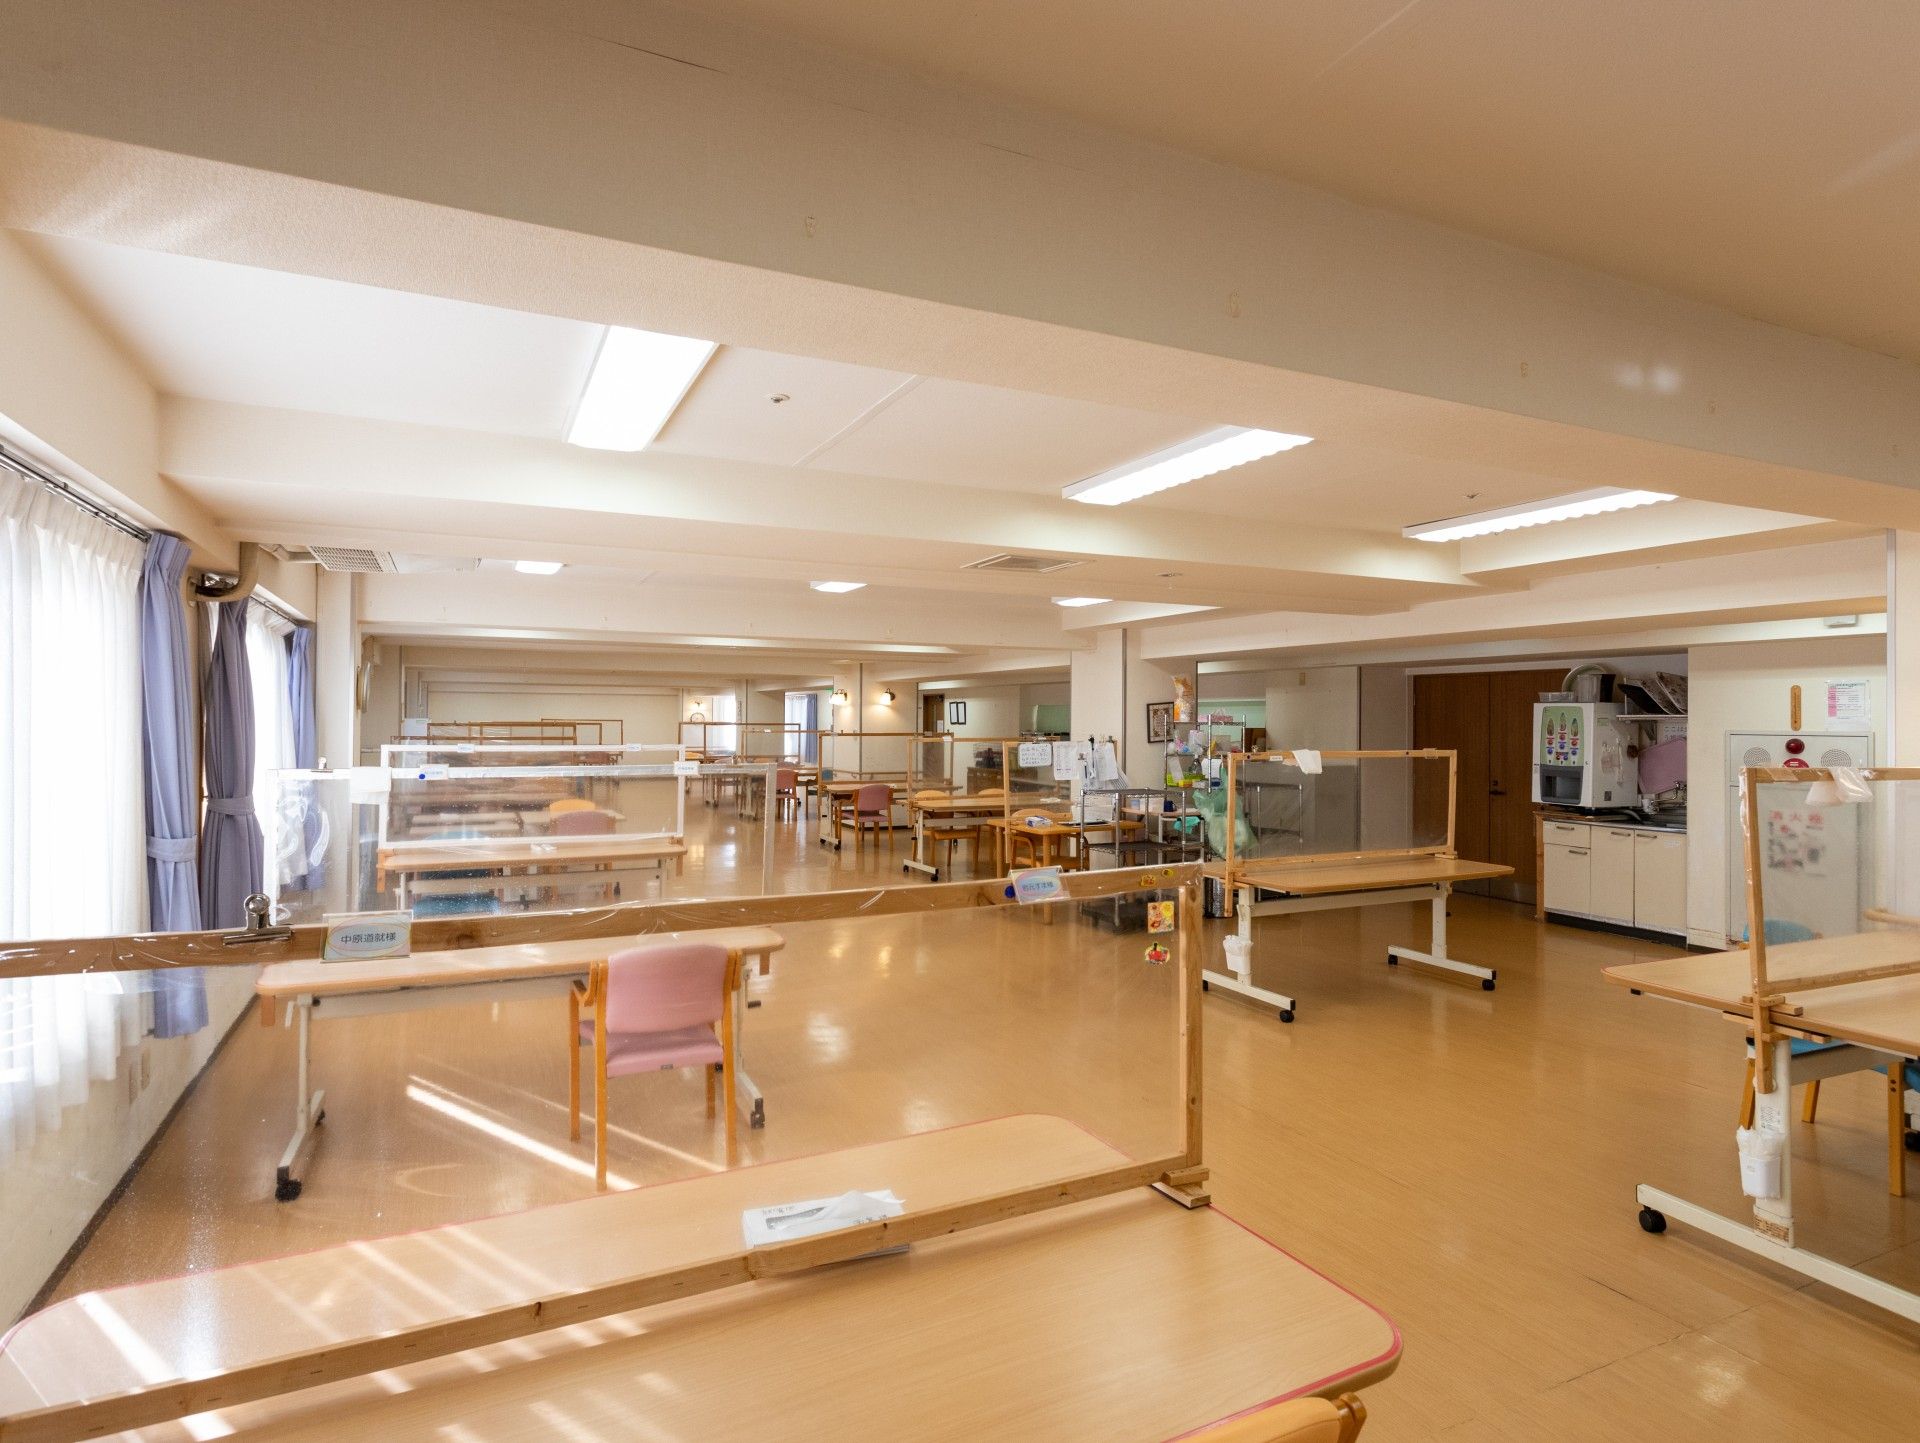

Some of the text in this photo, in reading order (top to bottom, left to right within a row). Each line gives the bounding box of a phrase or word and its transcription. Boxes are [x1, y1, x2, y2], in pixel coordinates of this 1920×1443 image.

[341, 932, 396, 944] 中原道就様
